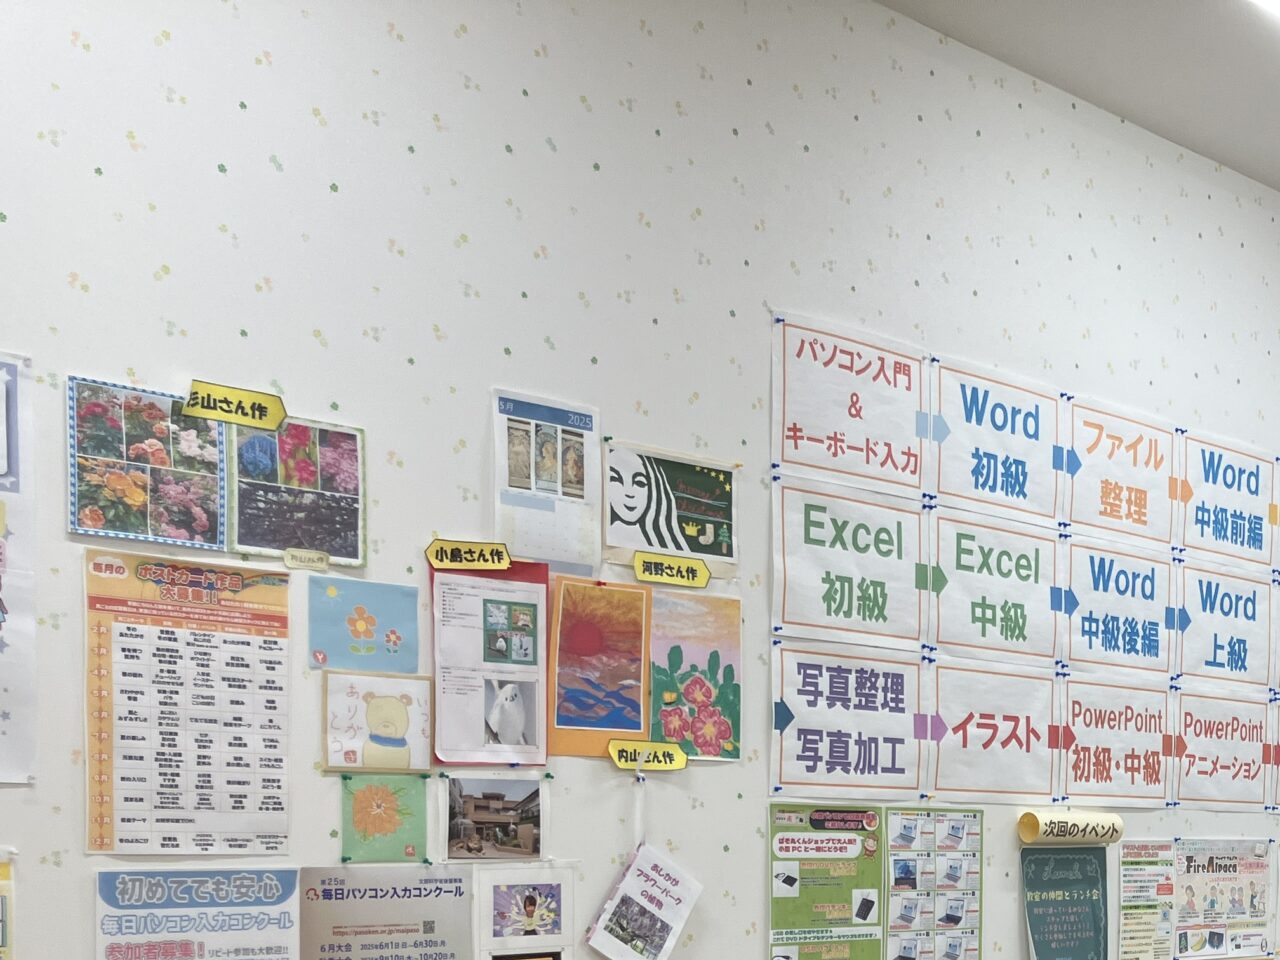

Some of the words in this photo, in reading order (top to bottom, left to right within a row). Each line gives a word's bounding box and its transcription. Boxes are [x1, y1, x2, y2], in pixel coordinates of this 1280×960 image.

[796, 338, 912, 391] パソコン入門
[568, 413, 592, 428] 2025
[848, 392, 863, 420] &
[960, 383, 1040, 441] Word
[786, 423, 919, 476] キーボード入力
[1083, 420, 1164, 472] ファイル
[971, 447, 1028, 500] 初級
[1201, 449, 1260, 497] Word
[1099, 479, 1148, 526] 整理
[804, 503, 902, 560] Excel
[1195, 501, 1263, 550] 中級前編
[93, 562, 126, 575] 毎月の
[435, 547, 504, 563] 小島さん作
[642, 560, 697, 580] 河野さん作
[956, 532, 1040, 584] Excel
[138, 565, 242, 590] ポストカード作品
[822, 570, 888, 623] 初級
[1089, 555, 1155, 601] Word
[971, 596, 1028, 642] 中級
[1198, 579, 1256, 622] Word
[1081, 610, 1160, 658] 中級後編
[1204, 633, 1248, 672] 上級
[797, 662, 906, 714] 写真整理
[952, 712, 1041, 753] イラスト
[1072, 700, 1162, 734] PowerPoint
[1184, 712, 1263, 743] PowerPoint
[796, 728, 906, 775] 写真加工
[1072, 744, 1161, 786] 初級・中級
[1185, 753, 1261, 781] アニメーション
[1043, 820, 1119, 839] 次回のイベント
[116, 873, 281, 905] 初めてでも安心
[321, 886, 464, 900] 毎日パソコン入力コンクール
[636, 868, 682, 905] フラワーパーク
[651, 863, 680, 887] あしかが
[1027, 889, 1100, 901] 教室の仲間とランチ会
[101, 912, 293, 935] 毎日パソコン入力コンクール
[320, 943, 352, 952] 6月大会
